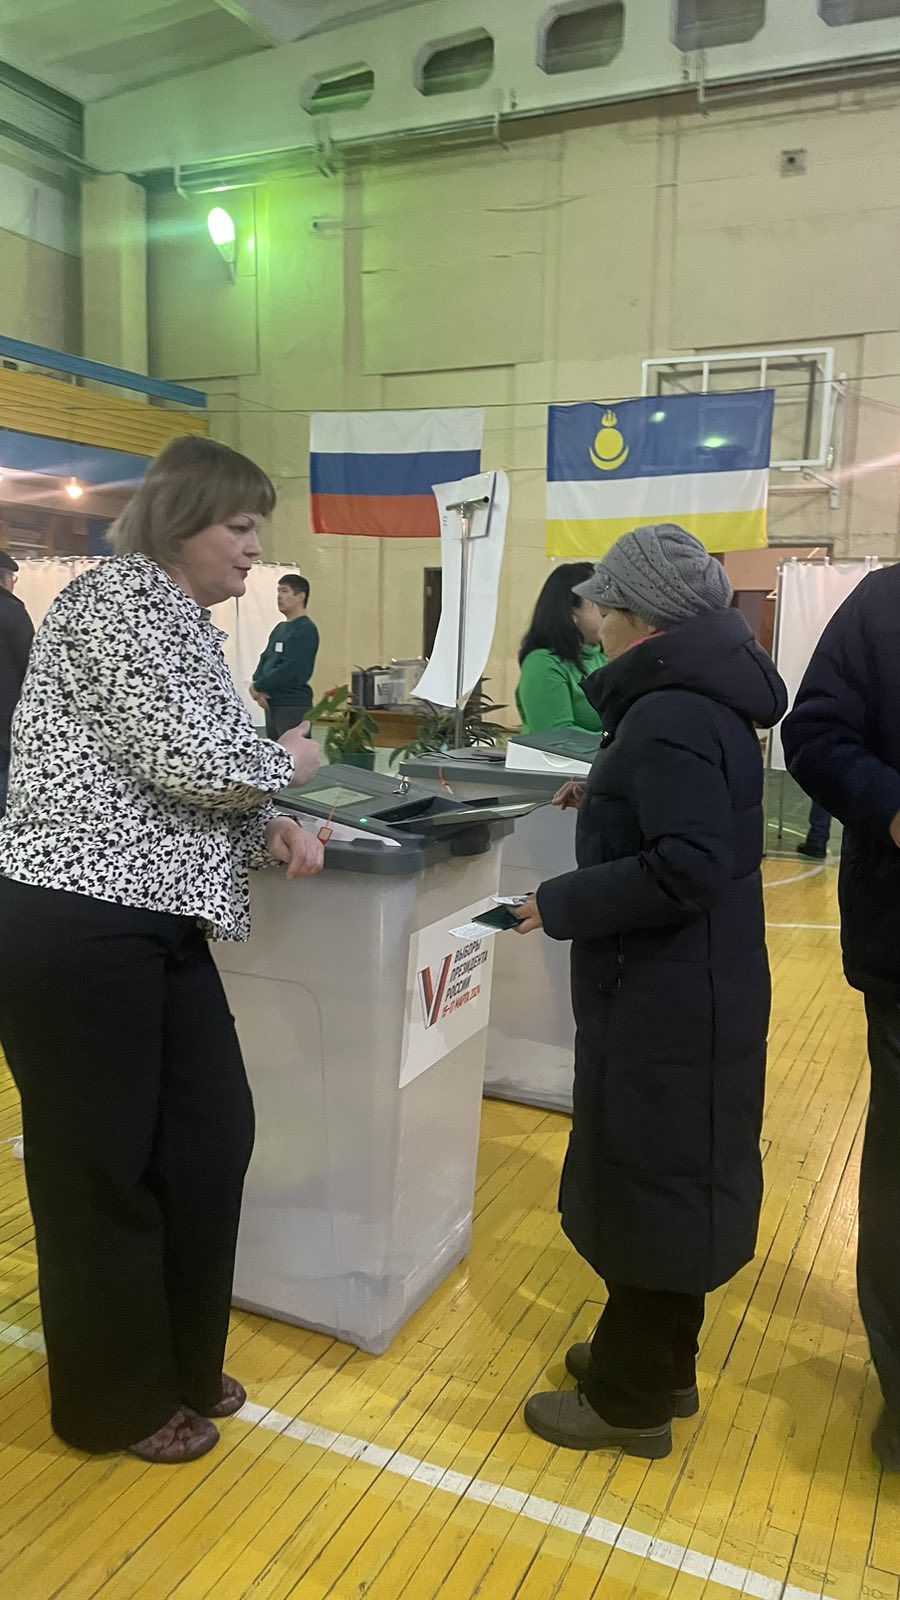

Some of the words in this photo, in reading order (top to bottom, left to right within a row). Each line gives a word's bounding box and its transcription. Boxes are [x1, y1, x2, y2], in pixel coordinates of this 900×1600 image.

[454, 938, 482, 963] ВЫБОРЫ
[450, 950, 488, 982] ПРЕЗИДЕНТА
[445, 975, 471, 1001] РОССИИ
